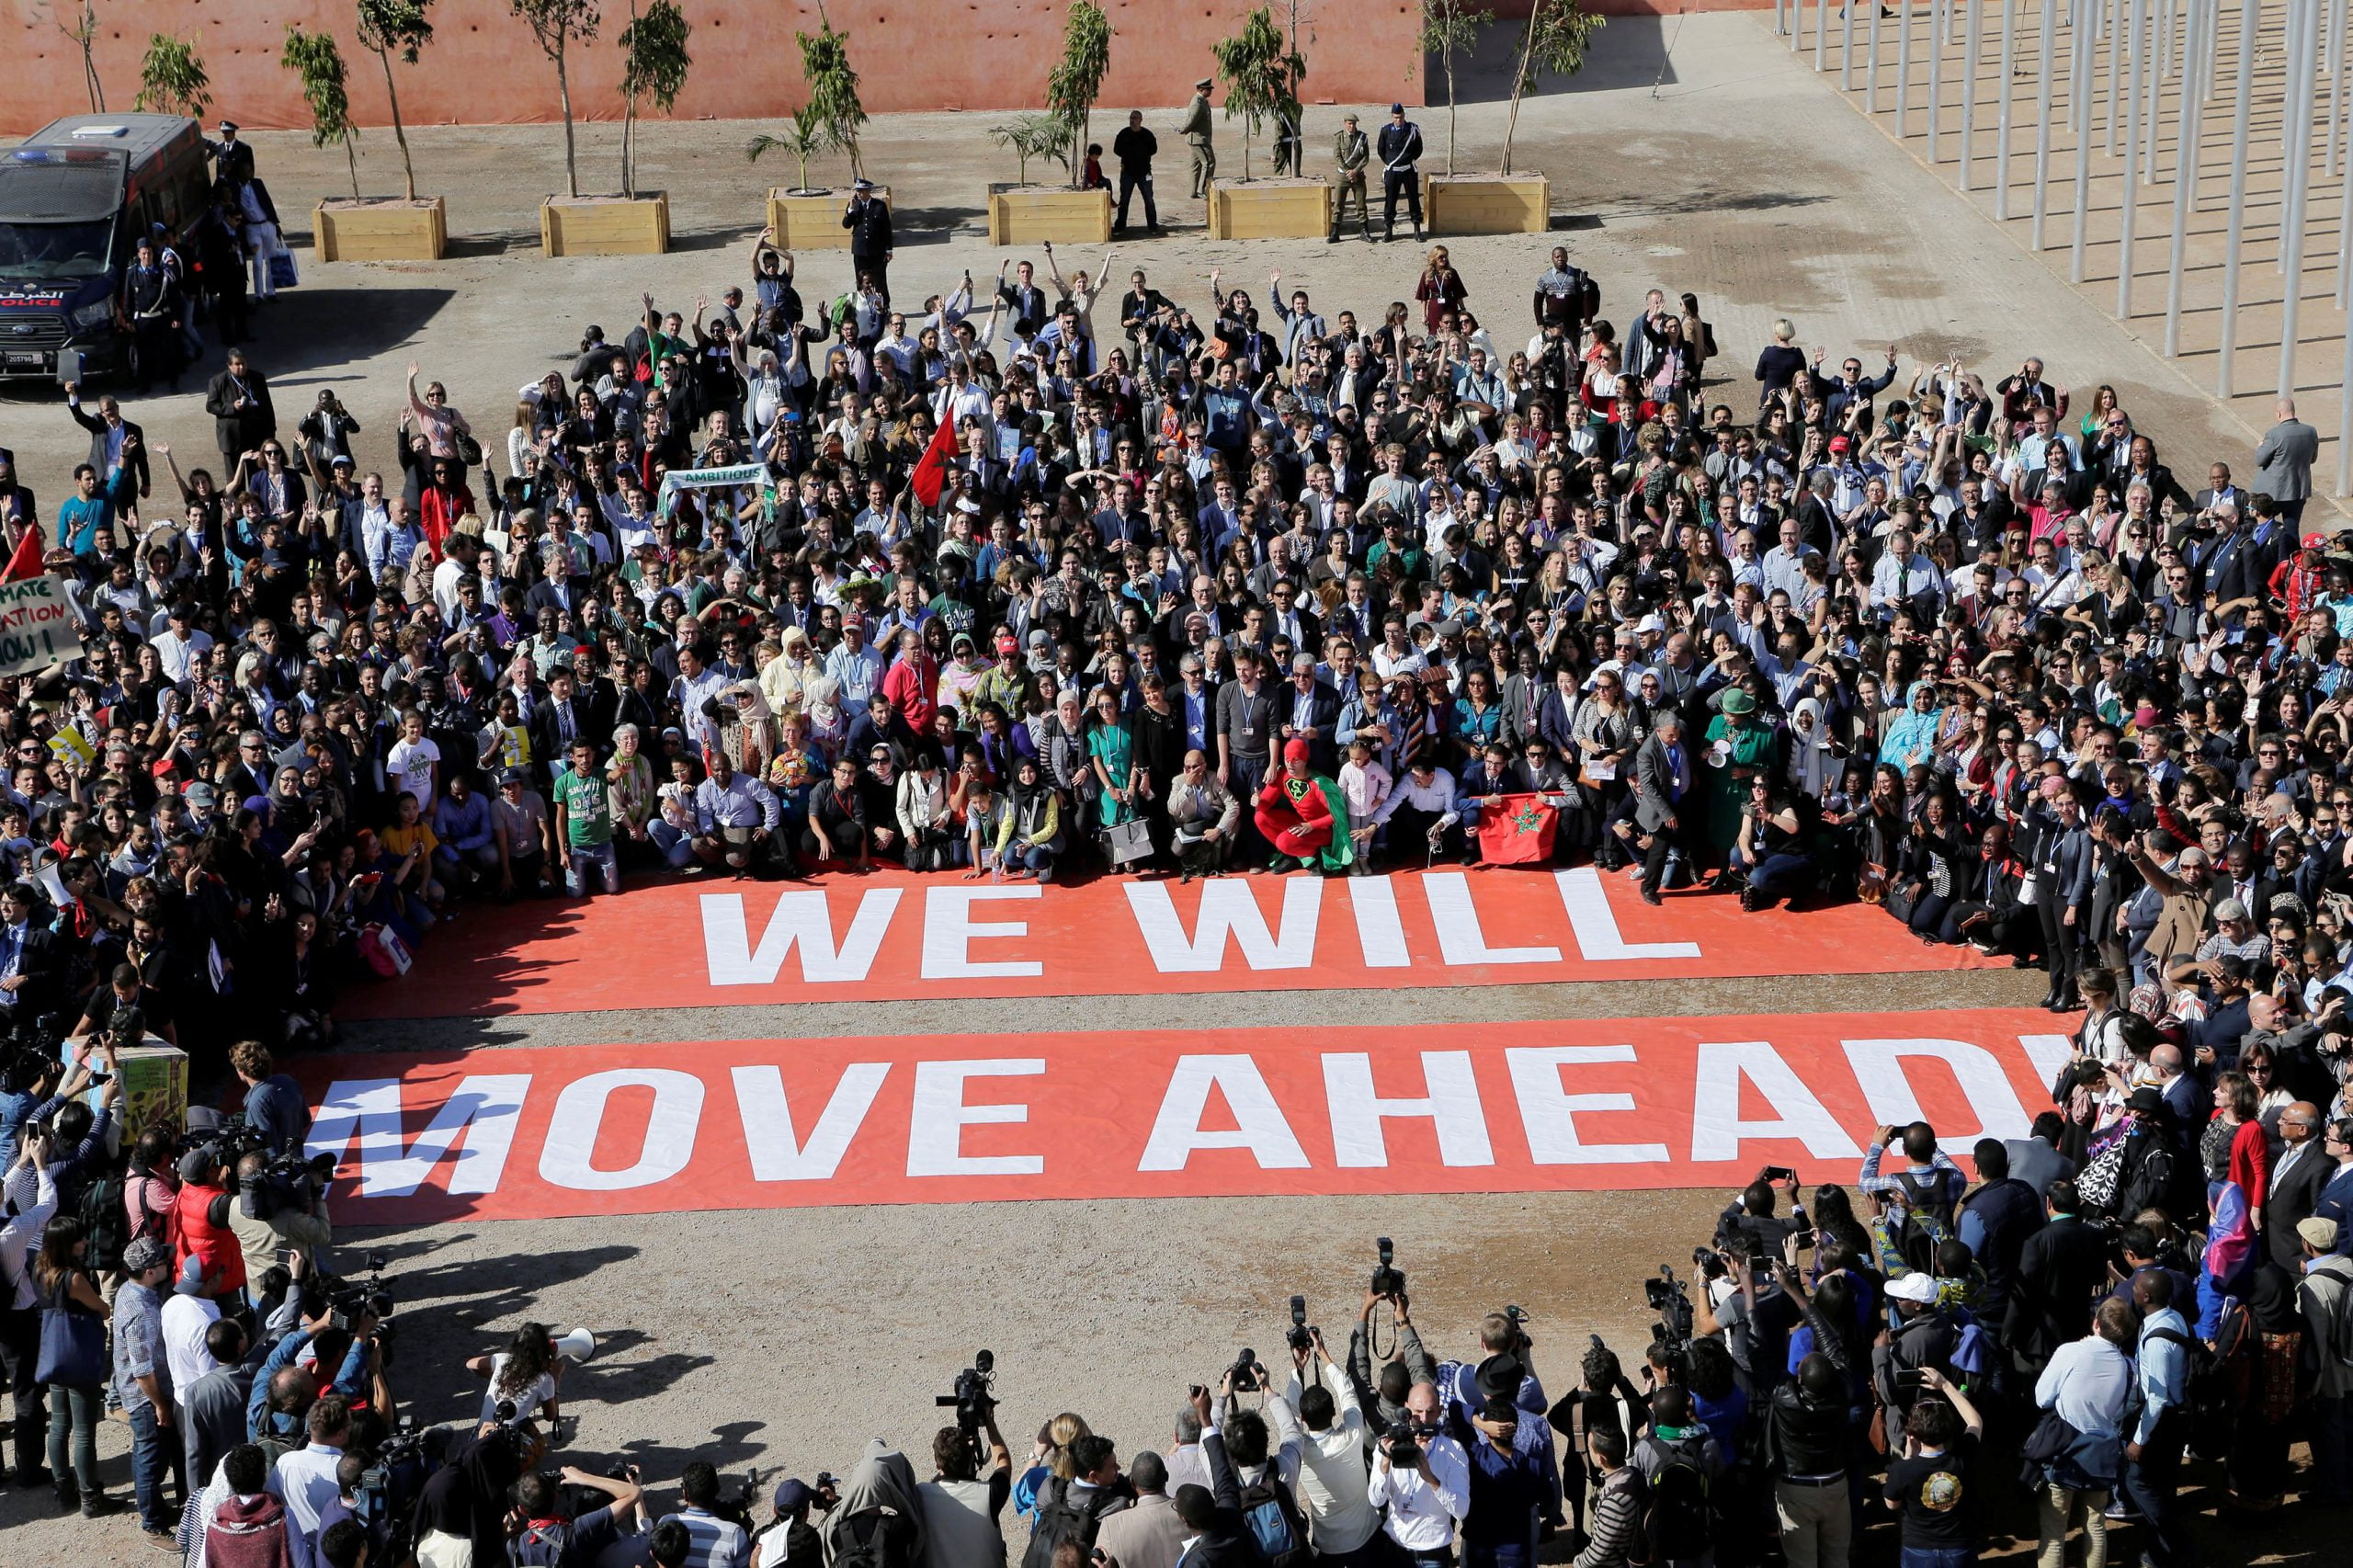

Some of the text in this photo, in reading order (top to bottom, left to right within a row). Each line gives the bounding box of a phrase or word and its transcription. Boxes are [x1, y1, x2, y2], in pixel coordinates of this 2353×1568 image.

[685, 468, 762, 483] AMBITIOUS
[945, 608, 975, 624] CAMP
[946, 618, 975, 631] CLIATE
[700, 867, 1701, 986] WE WILL
[303, 1060, 1046, 1199] MOVE
